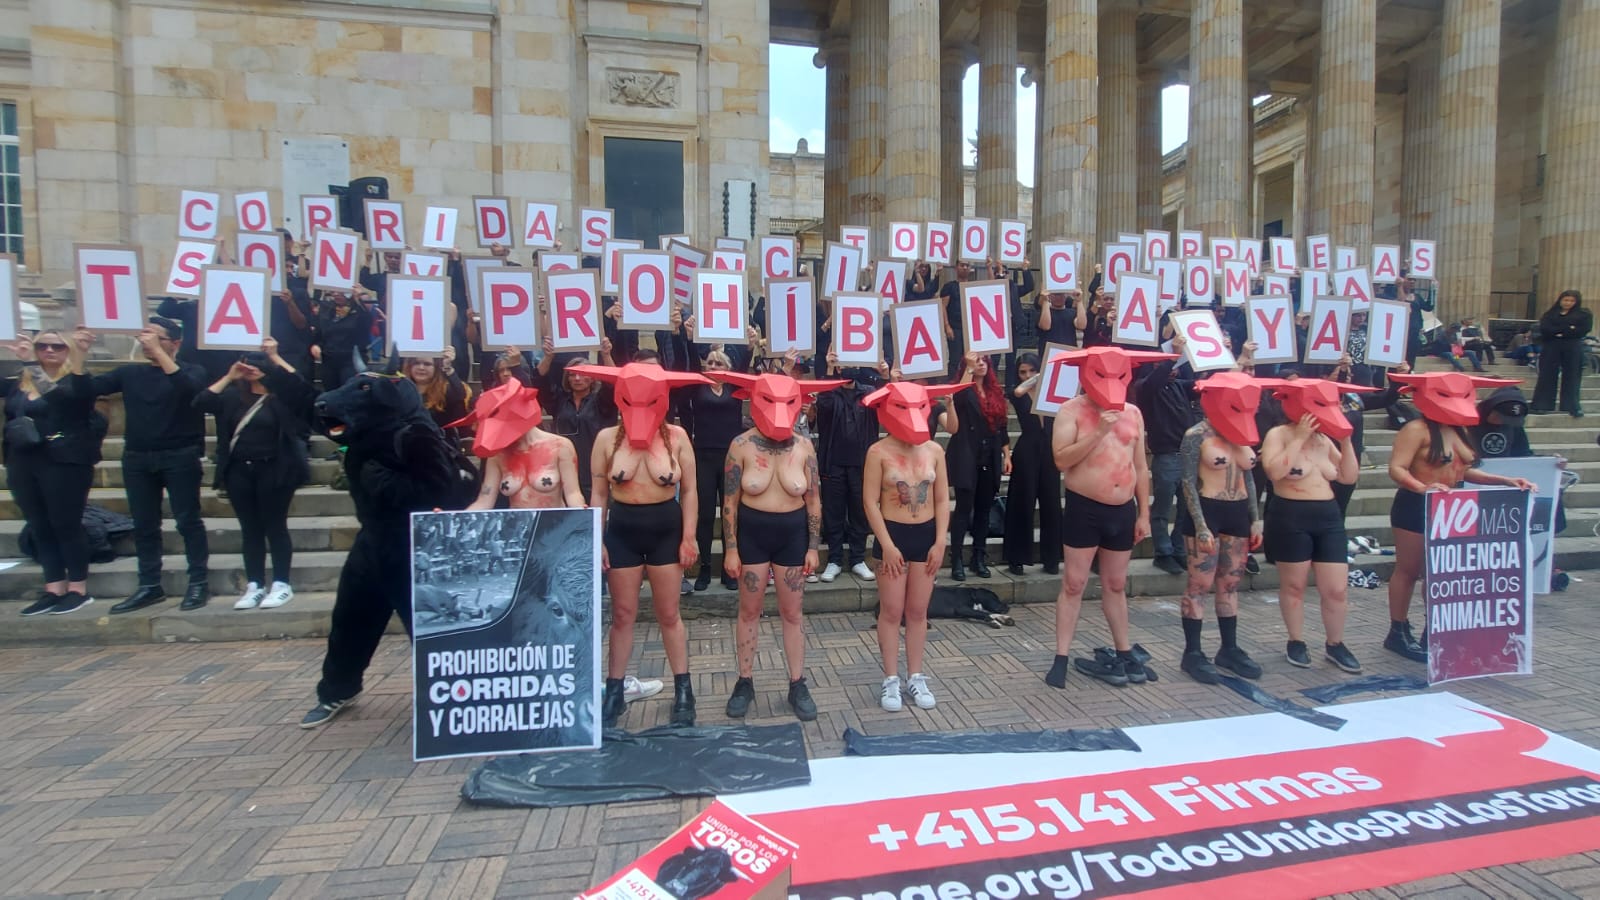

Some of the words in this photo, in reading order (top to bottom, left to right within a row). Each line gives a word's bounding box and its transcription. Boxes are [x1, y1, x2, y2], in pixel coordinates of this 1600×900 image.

[1430, 498, 1479, 540] NO
[1481, 503, 1521, 536] MÁS
[1430, 541, 1520, 574] VIOLENCIA
[1430, 575, 1485, 599] contra
[1491, 572, 1520, 593] los
[1431, 598, 1520, 634] ANIMALES
[427, 641, 547, 678] PROHIBICIÓN
[552, 644, 575, 670] DE
[429, 673, 576, 704] CORRIDAS
[429, 708, 445, 738] Y
[449, 701, 576, 736] CORRALEJAS
[868, 789, 1155, 851] +415.141
[1150, 766, 1383, 816] Firmas
[694, 820, 772, 874] TOROS
[706, 815, 740, 838] UNIDOS
[738, 835, 759, 851] POR
[758, 848, 779, 863] LOS
